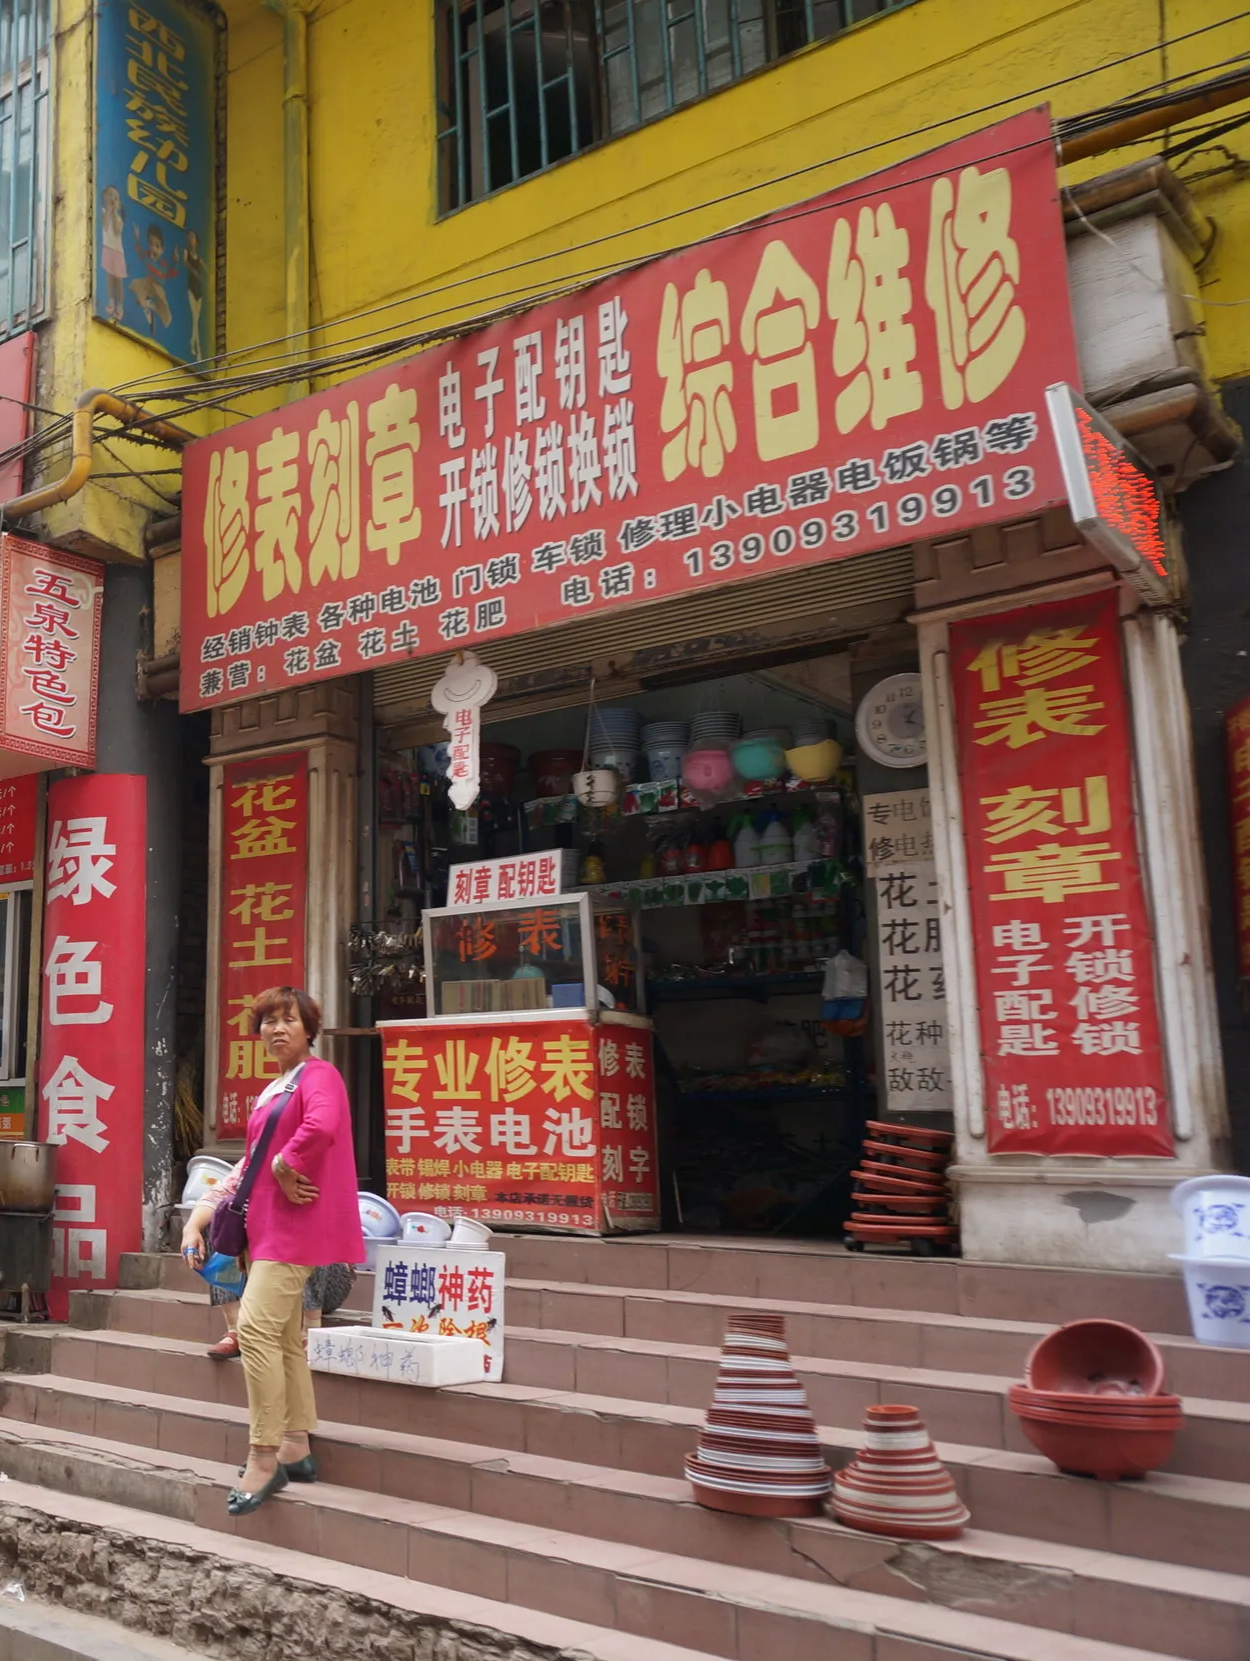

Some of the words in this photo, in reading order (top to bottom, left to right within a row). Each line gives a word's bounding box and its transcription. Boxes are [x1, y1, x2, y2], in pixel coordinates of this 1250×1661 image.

[124, 3, 189, 229] 西北民族幼儿园
[656, 166, 1028, 482] 综合维修
[438, 296, 632, 449] 电子配钥匙
[203, 383, 423, 618] 修表刻章
[439, 399, 639, 548] 开锁修锁换锁
[202, 612, 308, 663] 经销钟表
[318, 576, 441, 629] 各种电池
[454, 554, 519, 599] 门锁
[532, 531, 605, 573] 车锁
[620, 411, 1038, 556] 修理小电器电饭锅等
[285, 638, 342, 675] 花盆
[359, 621, 419, 656] 花土
[440, 597, 507, 640] 花肥
[684, 467, 1035, 576] 13909319913
[22, 570, 80, 735] 五泉特色包
[967, 624, 1108, 750] 修表
[451, 708, 472, 778] 电子配匙
[230, 774, 297, 860] 花盆
[979, 776, 1121, 903] 刻章
[454, 866, 491, 905] 刻章
[498, 856, 557, 900] 配钥匙
[228, 882, 294, 967] 花土
[991, 919, 1060, 1057] 电子配匙
[1063, 914, 1144, 1056] 开锁修锁
[42, 817, 116, 1280] 绿色食品
[383, 1035, 595, 1102] 专业修表
[598, 1038, 646, 1079] 修表
[886, 1020, 943, 1047] 花种
[600, 1092, 648, 1131] 配锁
[888, 1067, 952, 1092] 敌敌
[1046, 1087, 1158, 1127] 13909319913
[385, 1106, 597, 1157] 手表电池
[386, 1158, 416, 1177] 表带
[453, 1160, 503, 1179] 小电器
[507, 1162, 595, 1183] 电子配钥匙
[602, 1145, 650, 1183] 刻字
[387, 1182, 416, 1200] 开锁
[419, 1182, 451, 1200] 修锁
[453, 1184, 488, 1202] 刻章
[472, 1208, 593, 1226] 13909319913
[383, 1260, 494, 1313] 蟑螂神药
